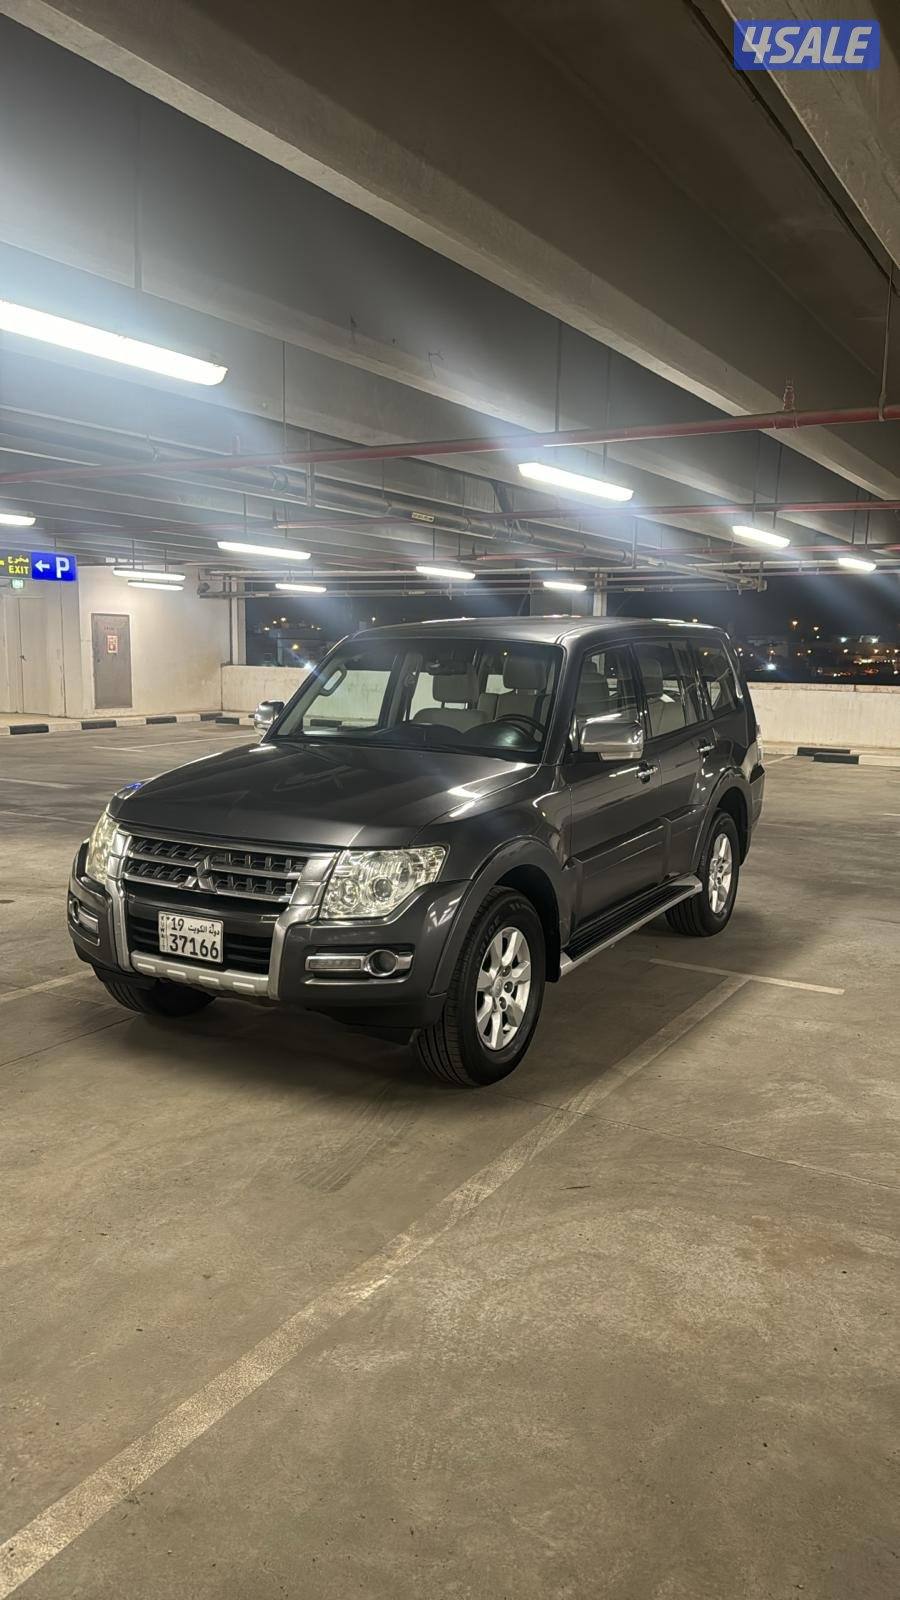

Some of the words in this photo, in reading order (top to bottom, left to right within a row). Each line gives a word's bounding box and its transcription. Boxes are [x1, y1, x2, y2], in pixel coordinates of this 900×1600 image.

[8, 565, 29, 574] EXIT
[55, 556, 70, 579] P
[171, 918, 184, 932] 19
[169, 933, 219, 959] 37166
